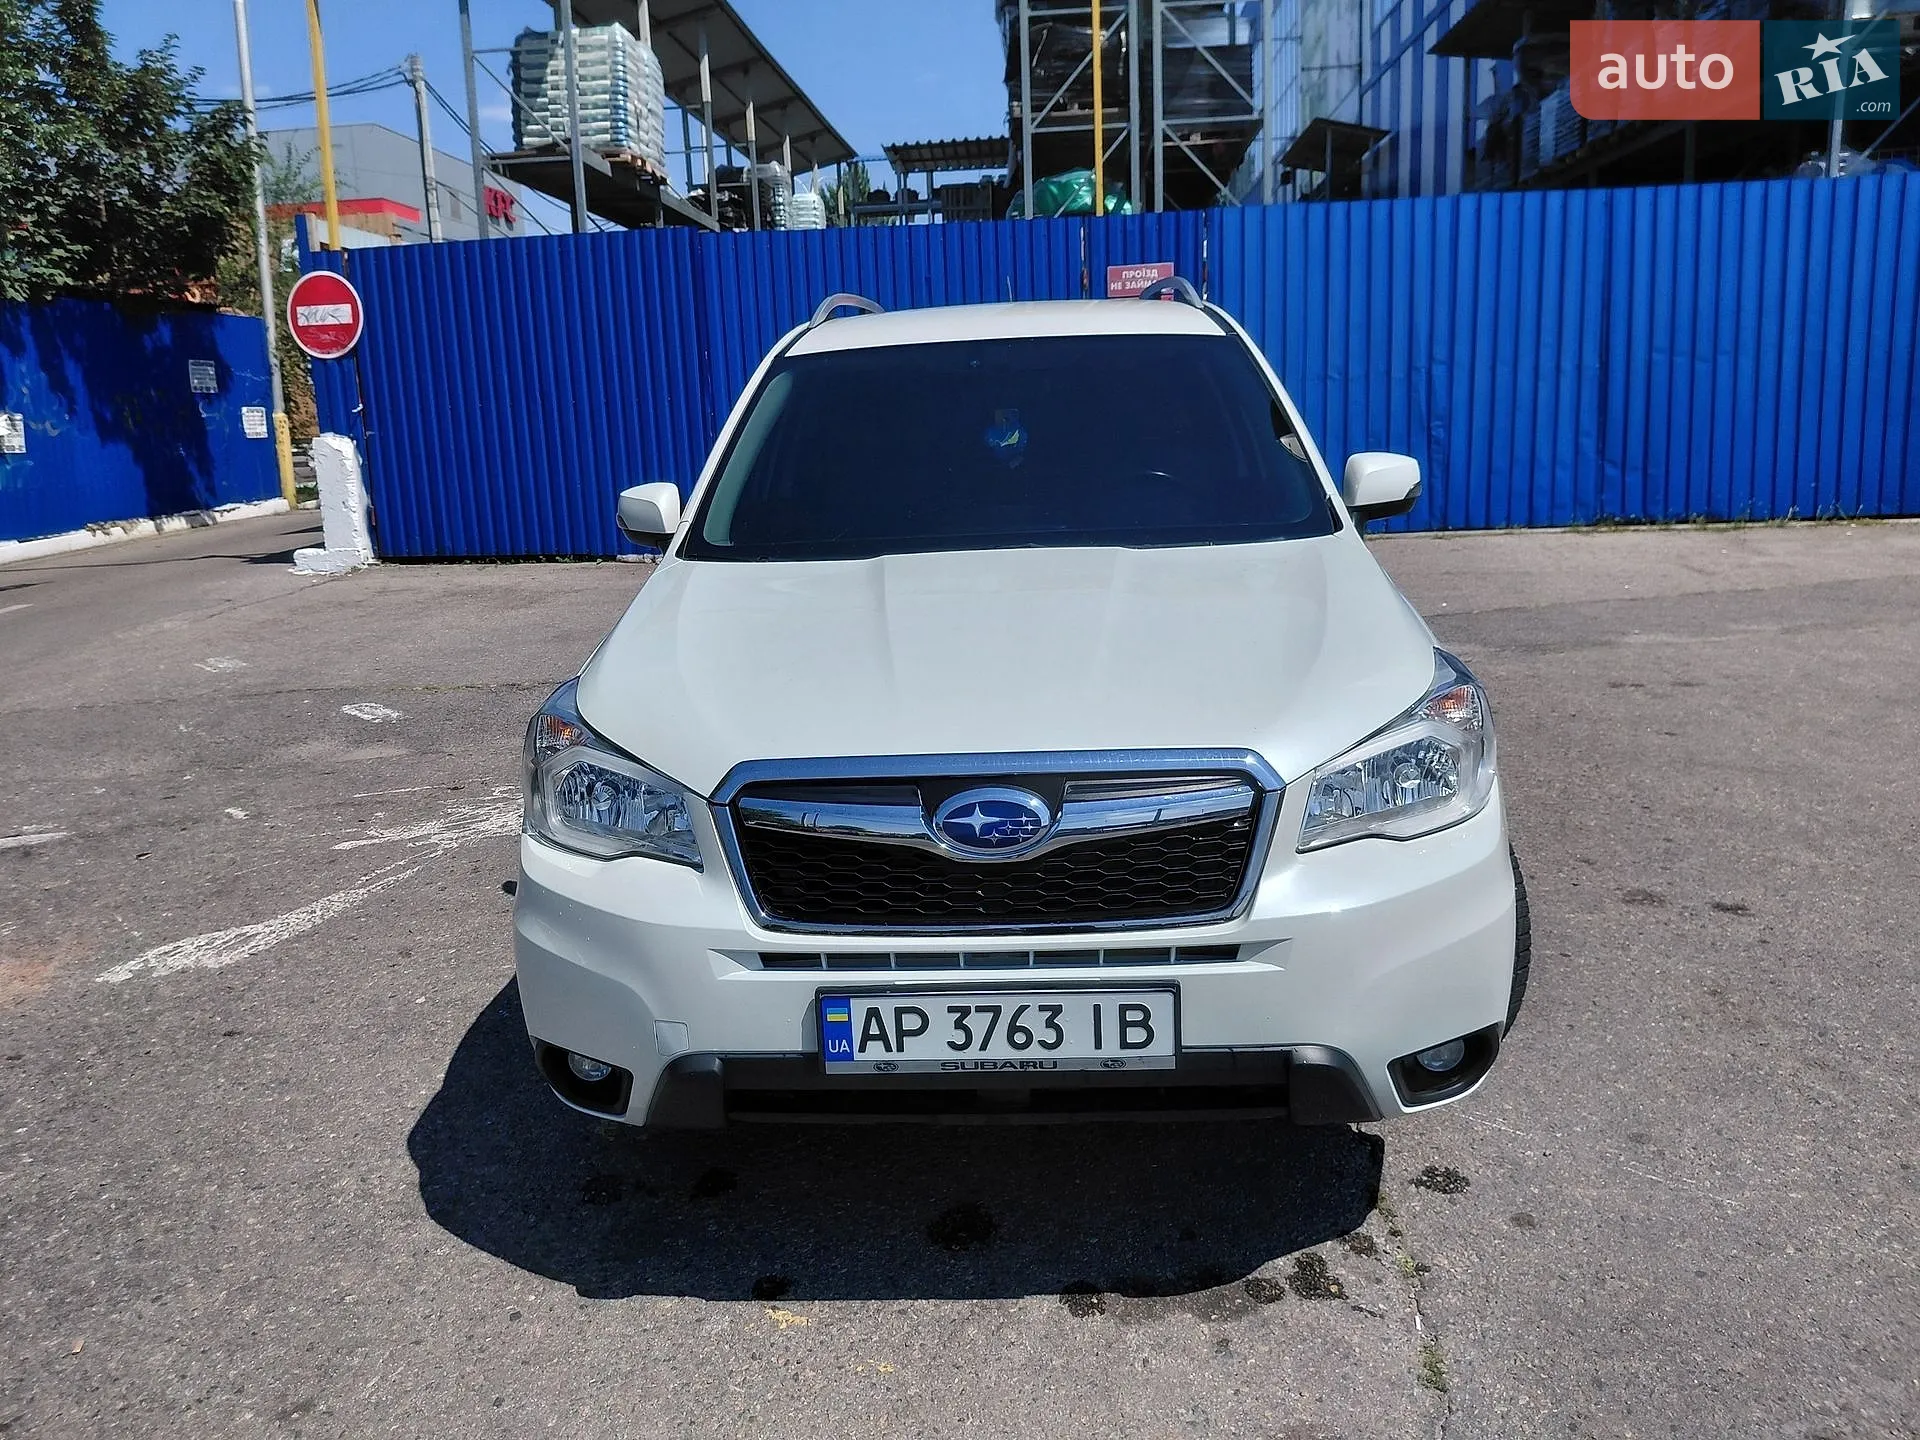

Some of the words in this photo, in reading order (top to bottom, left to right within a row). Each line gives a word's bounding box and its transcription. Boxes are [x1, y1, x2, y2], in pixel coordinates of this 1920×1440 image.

[1122, 268, 1158, 279] ПРОЇЗД
[1110, 282, 1122, 291] НЕ
[857, 1006, 930, 1053] AP
[946, 1004, 1065, 1052] 3763
[1093, 1003, 1156, 1050] IB
[829, 1040, 850, 1053] UA
[940, 1060, 1058, 1071] SUBARU
